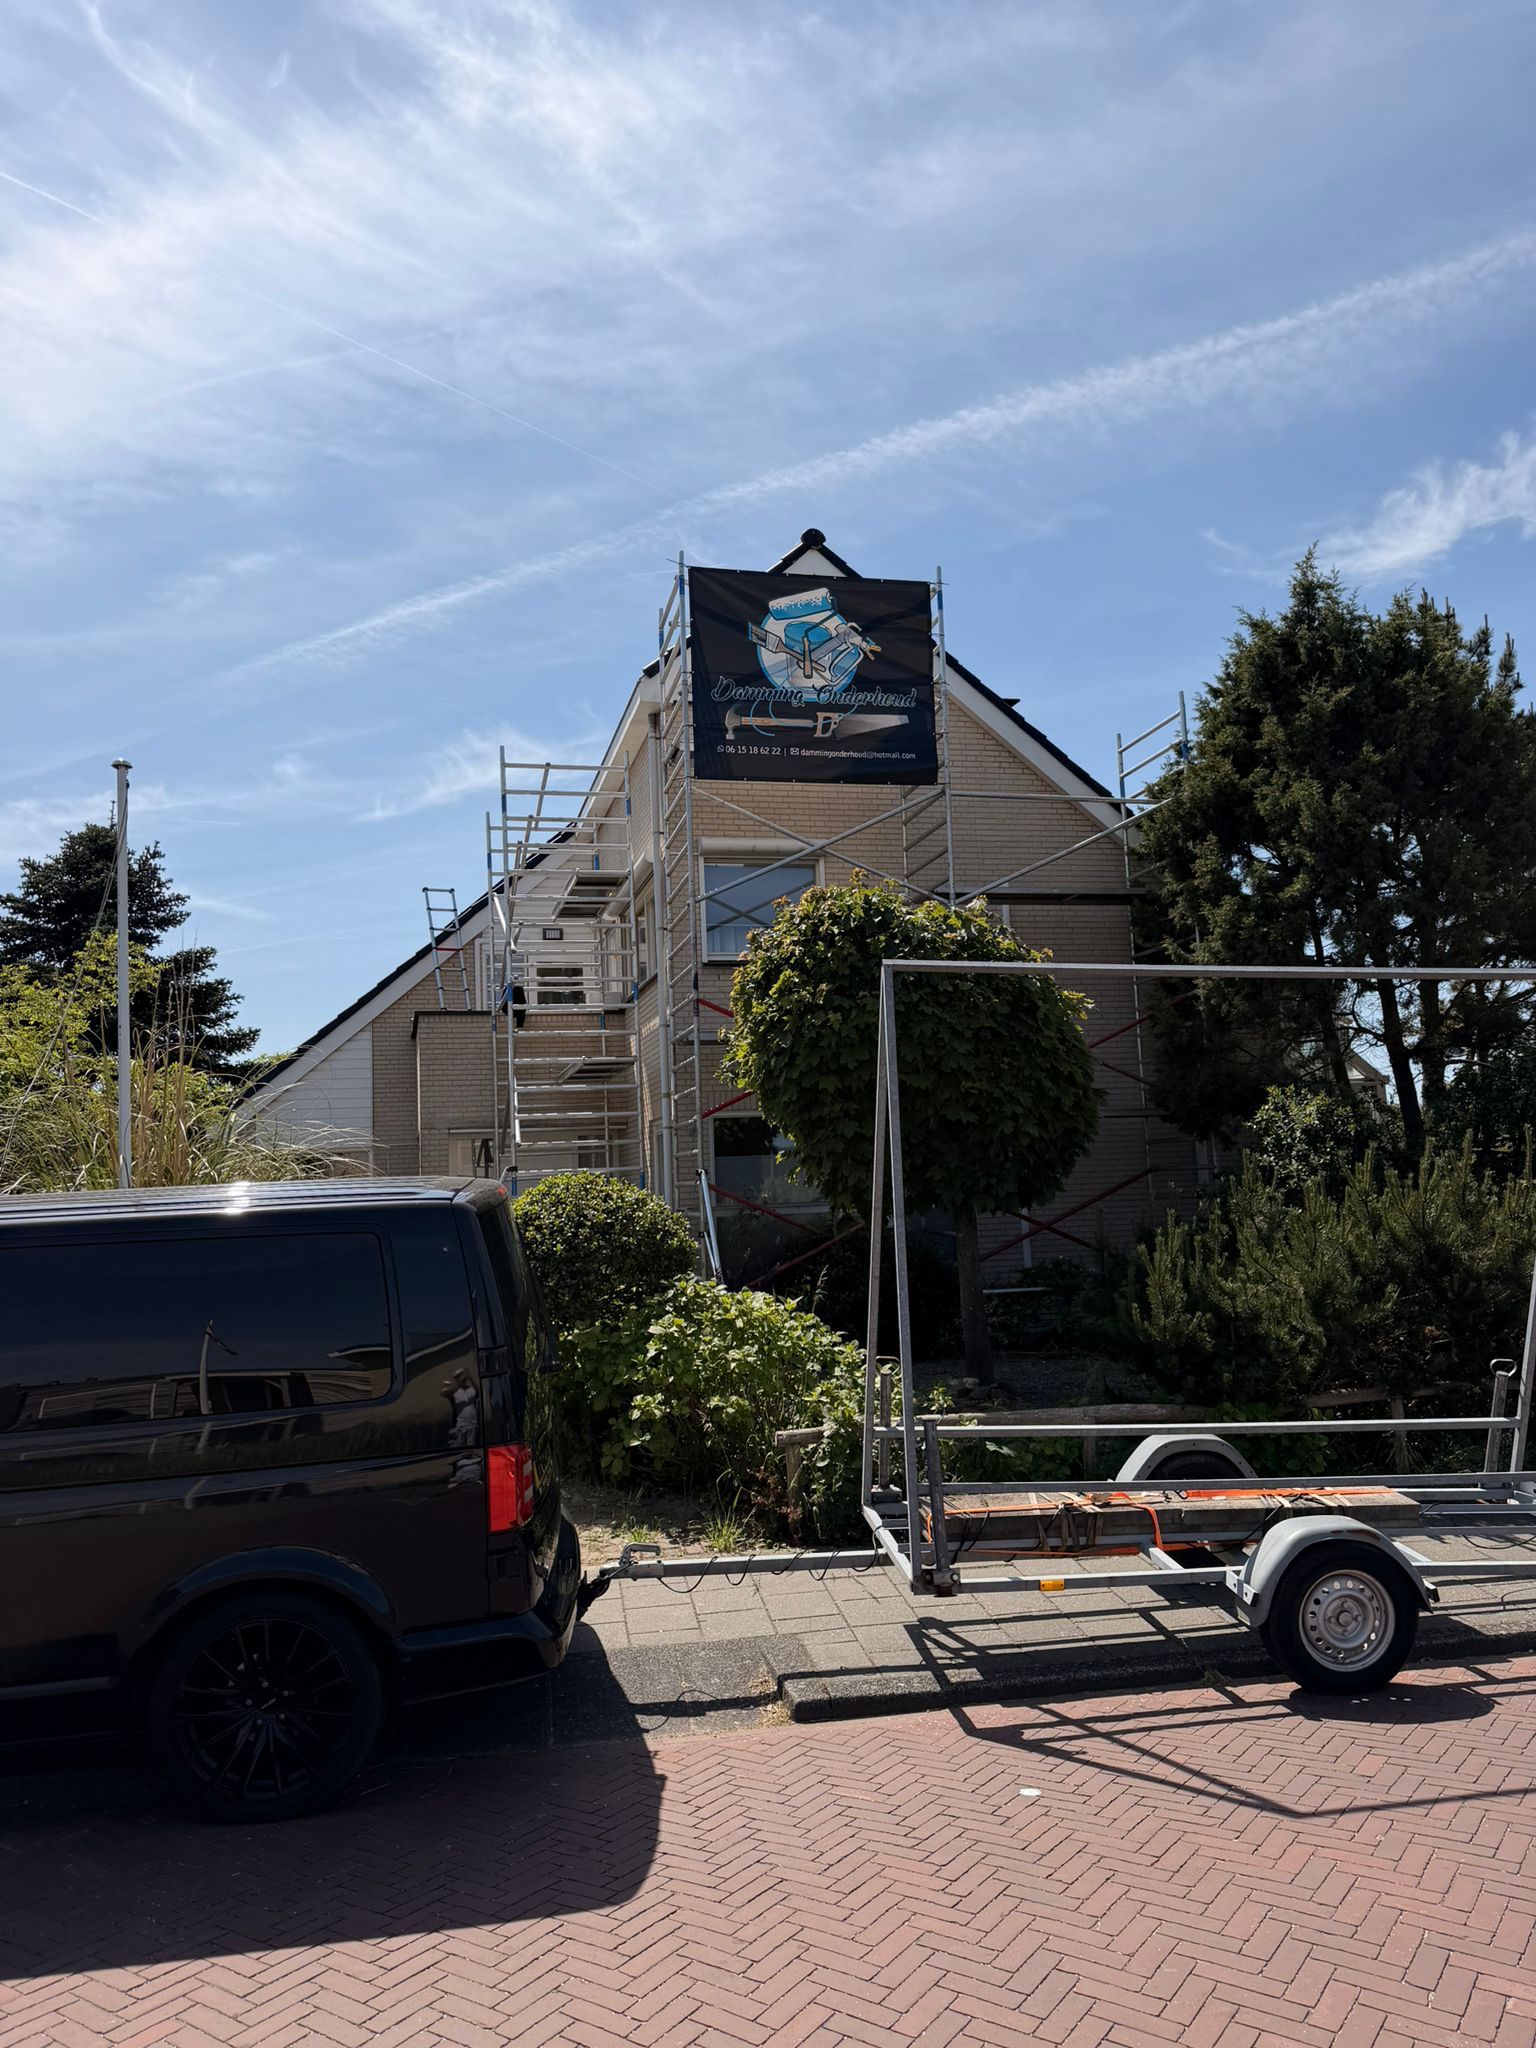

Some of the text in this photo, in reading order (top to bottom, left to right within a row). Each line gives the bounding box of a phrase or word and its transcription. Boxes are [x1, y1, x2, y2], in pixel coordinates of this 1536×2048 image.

[711, 676, 918, 708] Damming Onderhoud
[725, 745, 916, 759] 06 15 18 62 22 dammingonderhoud@hotmail.com
